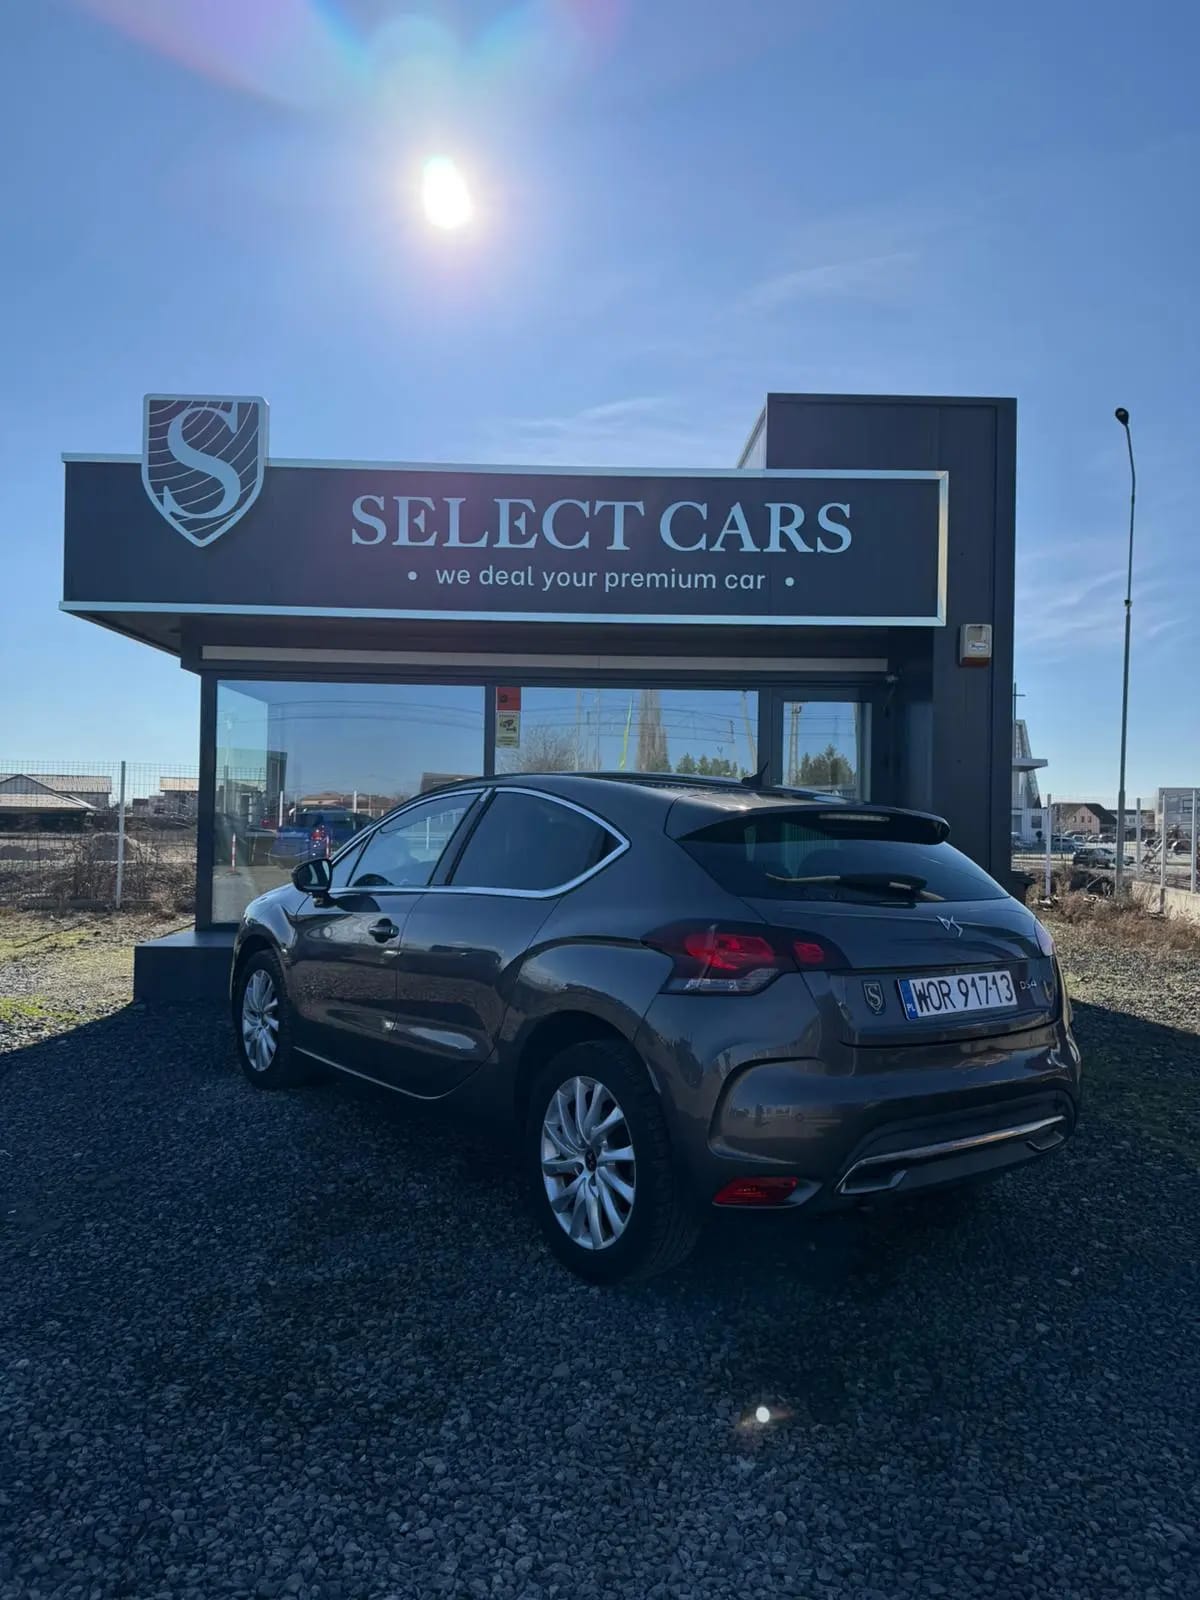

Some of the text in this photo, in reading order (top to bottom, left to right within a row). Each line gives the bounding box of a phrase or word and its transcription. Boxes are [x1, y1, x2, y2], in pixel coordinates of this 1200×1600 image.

[163, 400, 242, 520] S
[351, 494, 852, 555] SELECT CARS
[435, 564, 766, 593] we deal your premium car
[913, 979, 956, 1013] WOR
[957, 974, 1014, 1007] 91713
